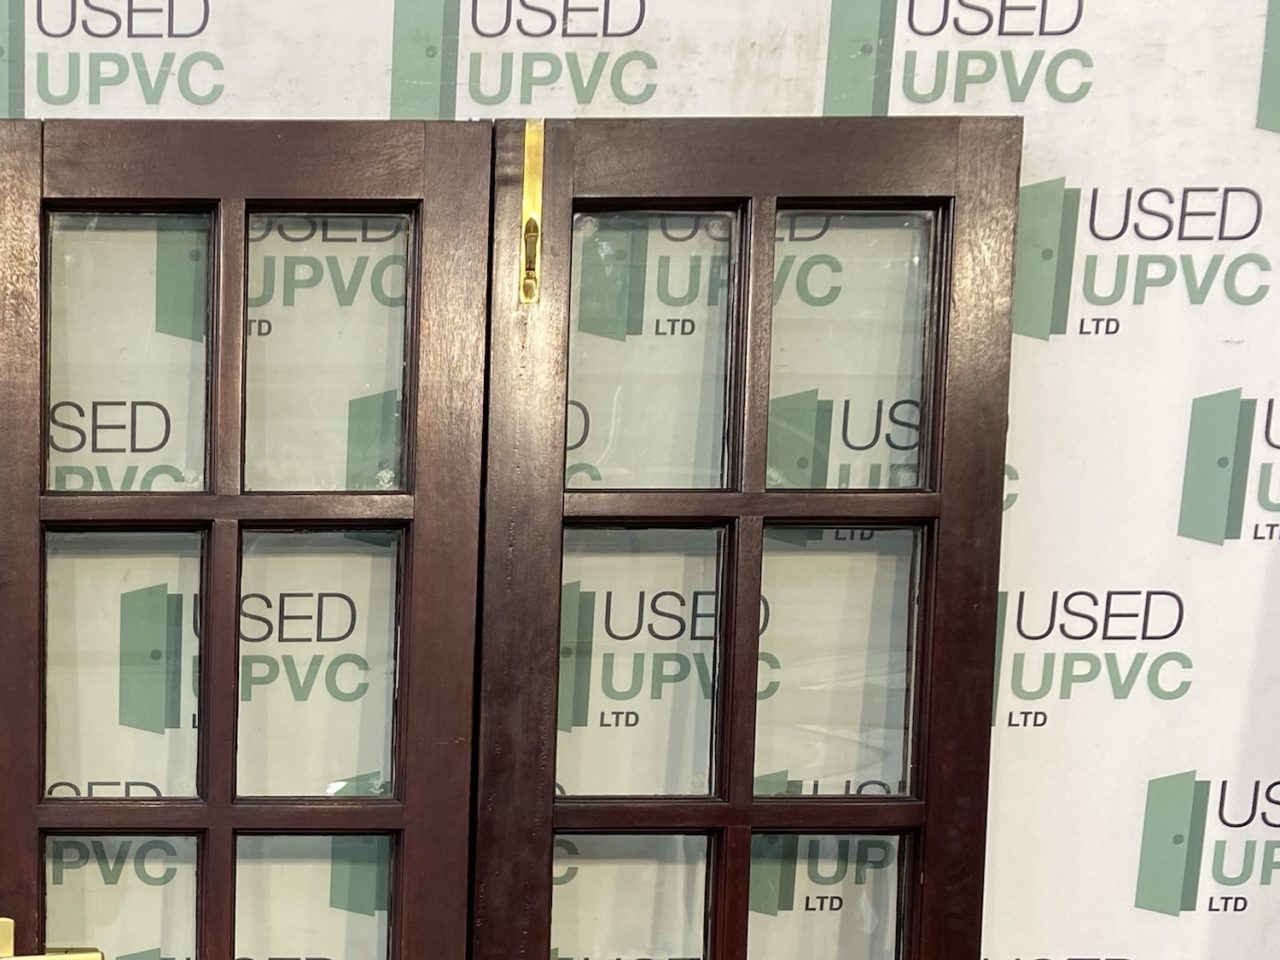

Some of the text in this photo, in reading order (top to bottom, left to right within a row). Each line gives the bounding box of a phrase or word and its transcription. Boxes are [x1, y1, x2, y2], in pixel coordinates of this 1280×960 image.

[36, 51, 225, 105] UPVC
[468, 51, 658, 105] UPVC
[902, 49, 1094, 103] UPVC
[1089, 187, 1263, 241] USED
[1082, 253, 1272, 306] UPVC
[247, 319, 272, 336] TD
[655, 318, 696, 336] LTD
[1079, 318, 1120, 335] LTD
[49, 400, 171, 454] SED
[842, 399, 920, 451] US
[1016, 591, 1184, 640] USED
[1011, 652, 1193, 701] UPVC
[599, 711, 640, 728] LTD
[1008, 712, 1047, 727] LTD
[52, 839, 178, 886] PVC
[807, 839, 894, 885] UP
[804, 895, 843, 911] LTD
[1208, 897, 1248, 912] LTD
